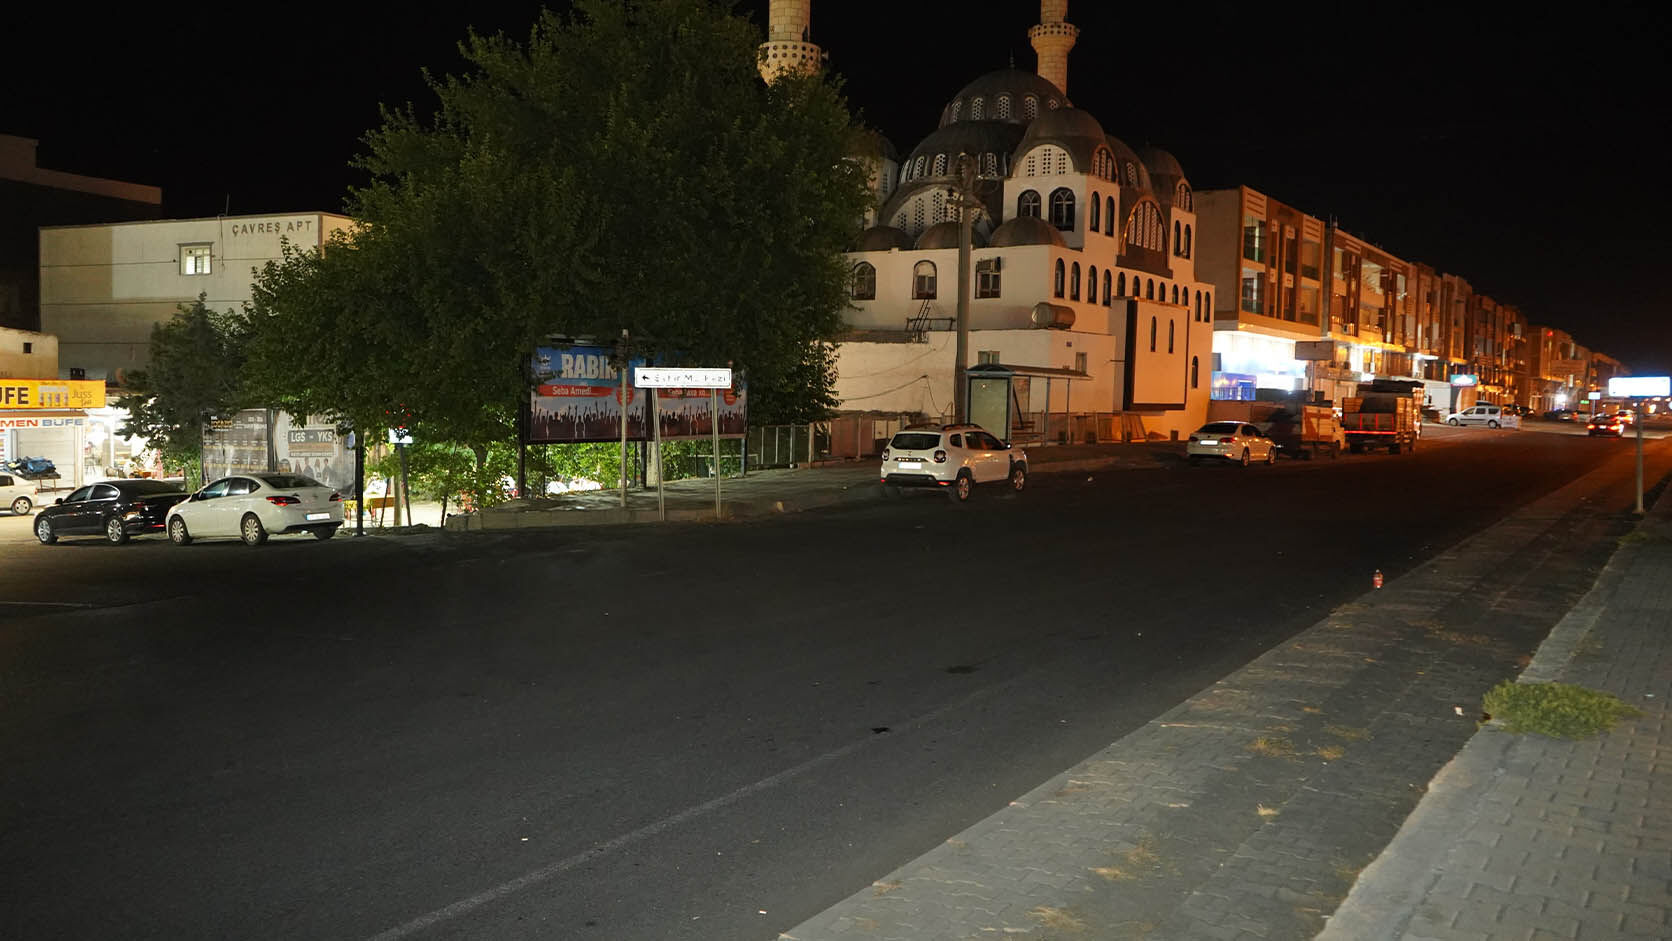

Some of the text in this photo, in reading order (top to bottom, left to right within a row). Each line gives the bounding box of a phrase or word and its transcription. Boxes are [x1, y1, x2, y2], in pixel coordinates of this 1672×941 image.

[232, 220, 312, 237] ÇAVREŞ APT
[0, 387, 29, 404] FE
[291, 432, 305, 442] LGS
[318, 432, 333, 442] YKS
